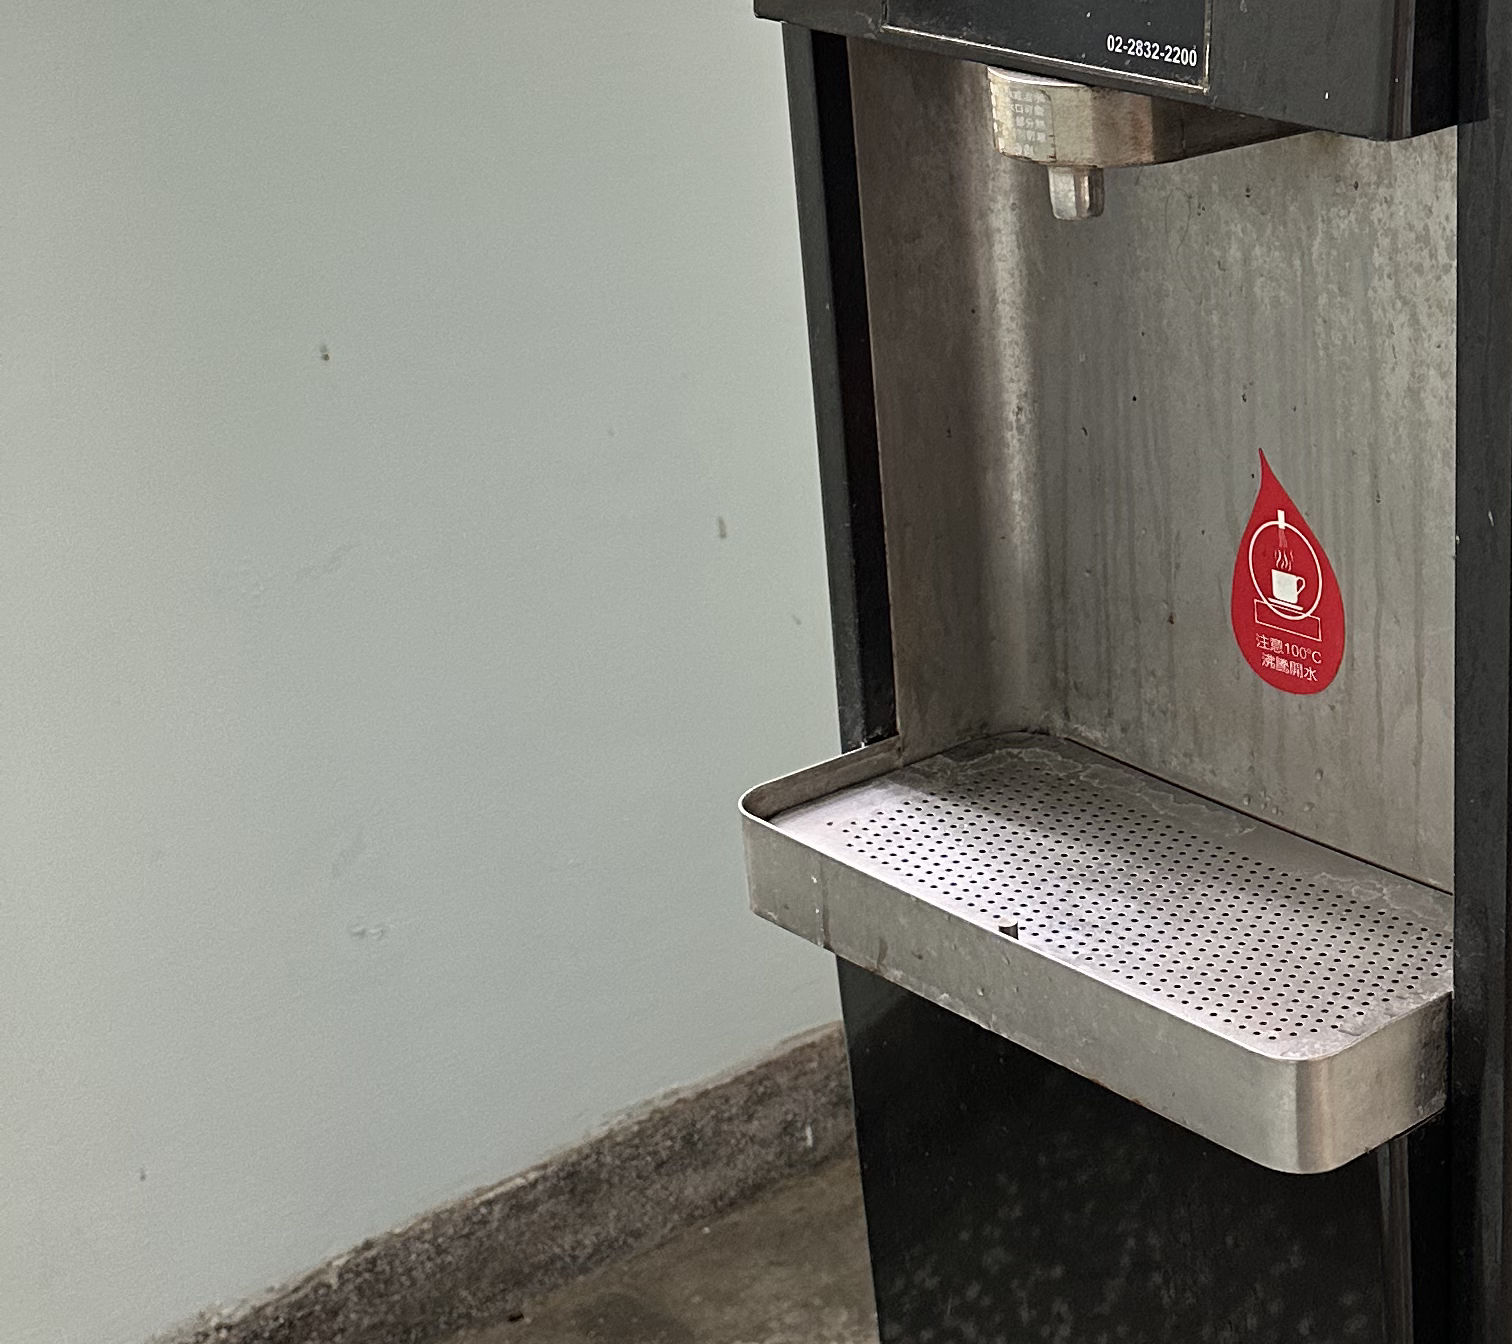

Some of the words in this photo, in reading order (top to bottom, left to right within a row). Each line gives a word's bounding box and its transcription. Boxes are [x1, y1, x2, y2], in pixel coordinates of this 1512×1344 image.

[1106, 34, 1197, 67] 02-2832-2200
[1260, 651, 1319, 682] 沸騰開水
